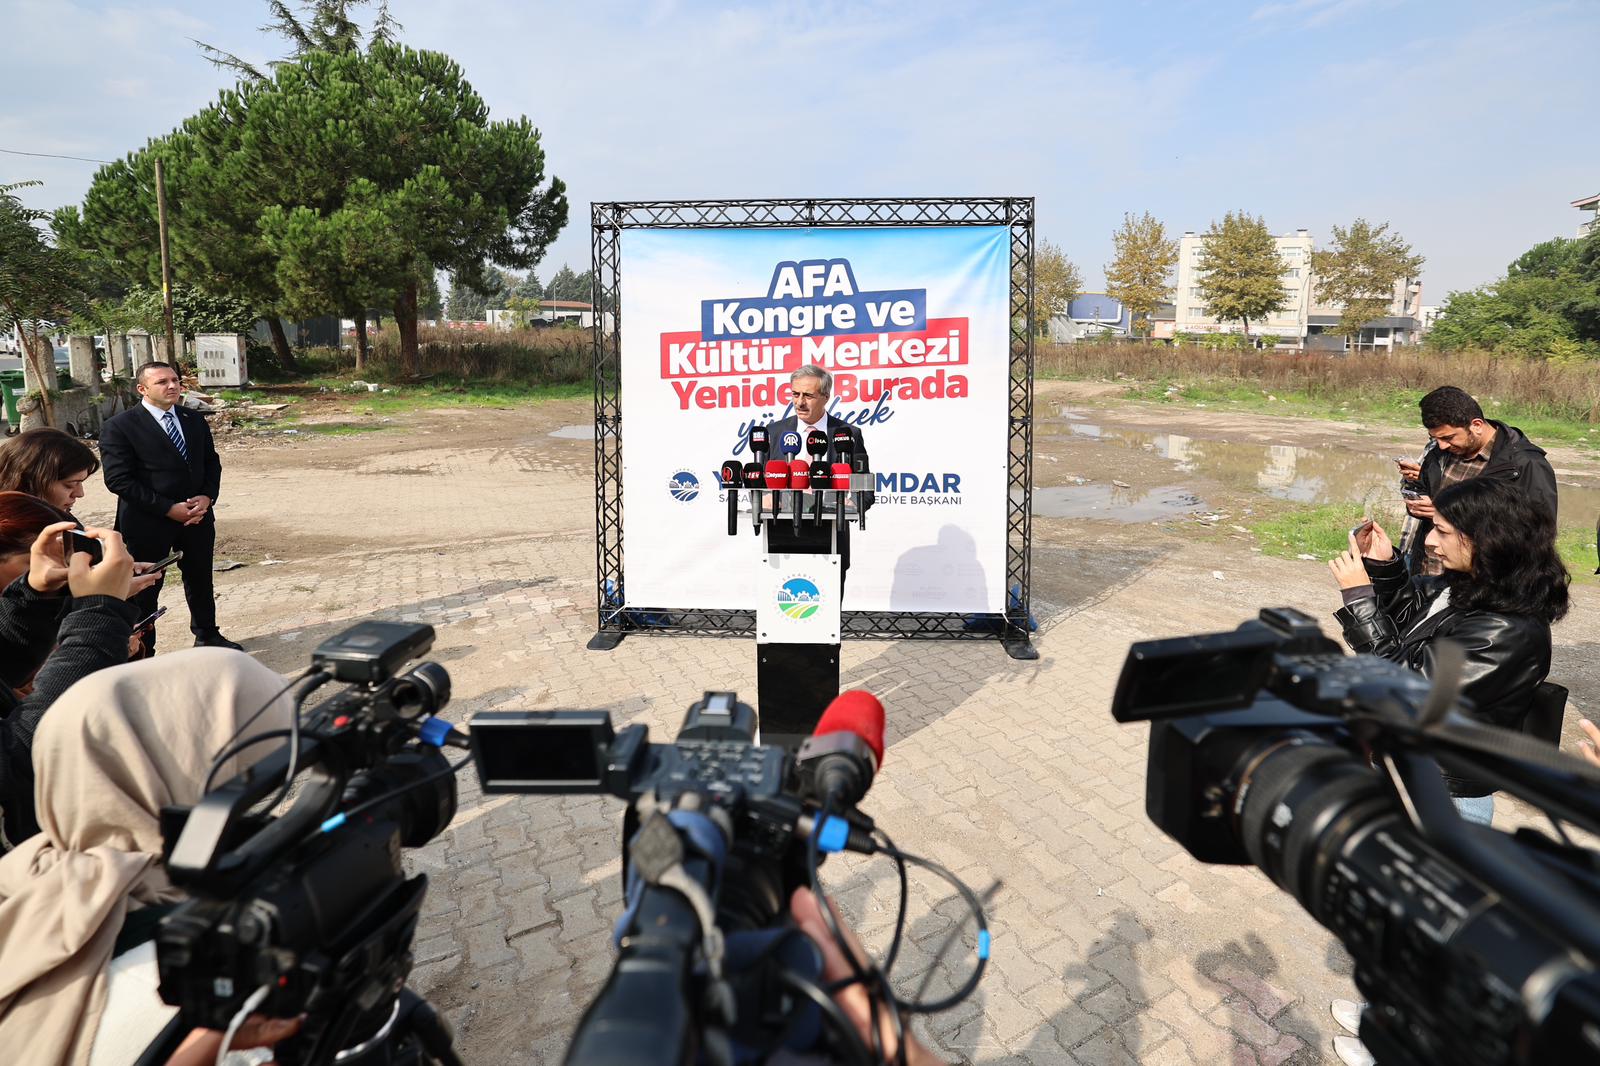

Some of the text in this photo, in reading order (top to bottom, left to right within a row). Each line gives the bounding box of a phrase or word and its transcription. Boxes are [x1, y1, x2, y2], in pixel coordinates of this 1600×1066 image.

[772, 264, 853, 299] AFA
[713, 300, 915, 335] Kongre ve
[668, 330, 960, 374] Kültür Merkezi
[671, 369, 968, 410] Yenide Burada
[876, 472, 961, 493] MDAR
[911, 496, 962, 506] BAŞKANI
